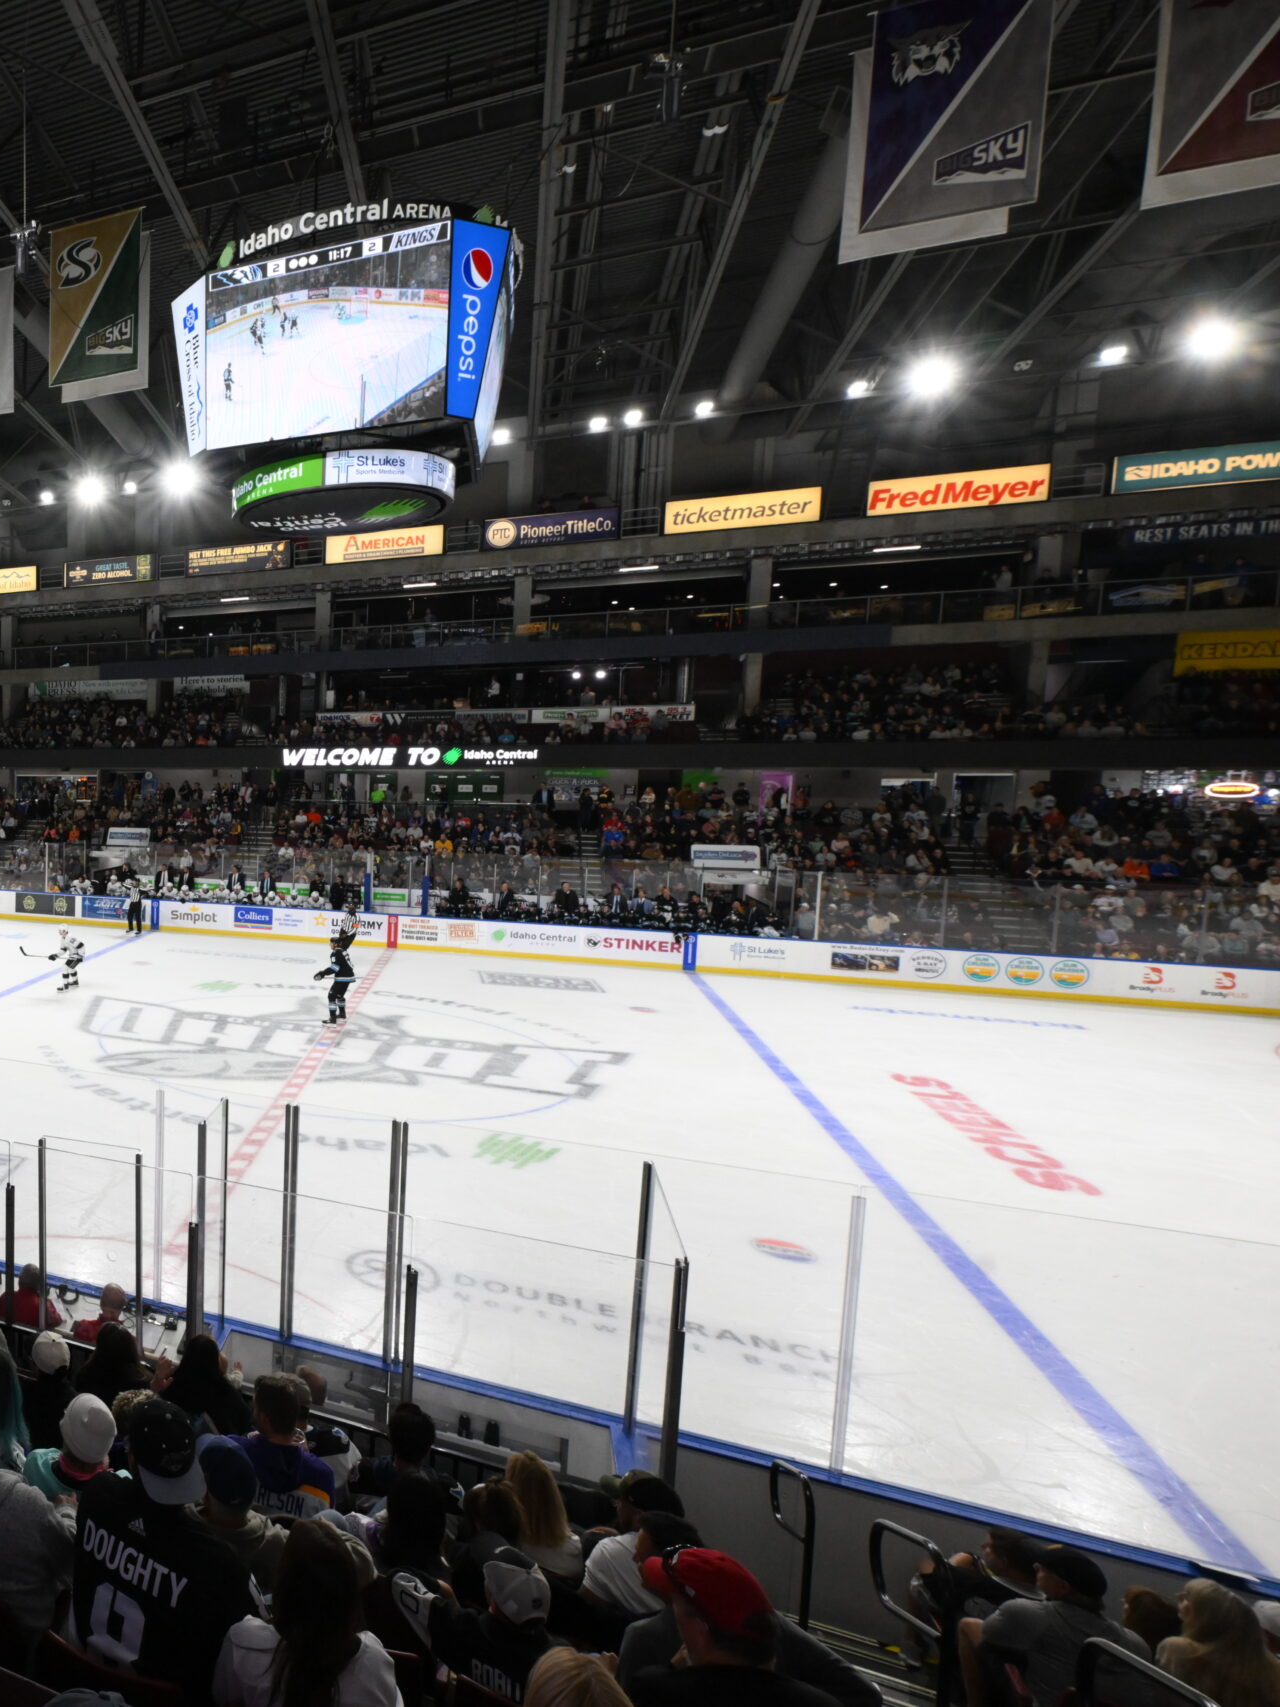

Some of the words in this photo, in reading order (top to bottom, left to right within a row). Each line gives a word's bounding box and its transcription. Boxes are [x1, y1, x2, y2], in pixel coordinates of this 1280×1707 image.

[972, 129, 1025, 167] SKY
[239, 223, 293, 259] Idaho
[299, 198, 389, 235] Central
[392, 203, 452, 219] ARENA
[394, 227, 436, 249] KINGS
[328, 246, 353, 261] 11:17
[105, 321, 131, 342] SKY
[458, 294, 481, 380] pepsi
[356, 455, 369, 467] St
[372, 456, 405, 467] Luke's
[1152, 458, 1221, 479] IDAHO
[256, 463, 303, 487] Central
[671, 495, 813, 528] ticketmaster
[492, 527, 510, 540] PTC
[1134, 529, 1174, 543] BEST
[1179, 523, 1230, 541] SEATS
[1235, 521, 1253, 536] IN
[344, 535, 425, 552] AMERICAN
[282, 747, 397, 766] WELCOME
[408, 747, 440, 766] TO
[464, 749, 494, 760] Idaho
[496, 749, 539, 760] Central
[171, 910, 218, 924] Simplot
[237, 911, 269, 921] Colliers
[510, 931, 538, 941] Idaho
[540, 933, 577, 943] Central
[602, 937, 682, 953] STINKER
[453, 1272, 618, 1319] DOUBLE
[82, 1517, 189, 1608] DOUGHTY
